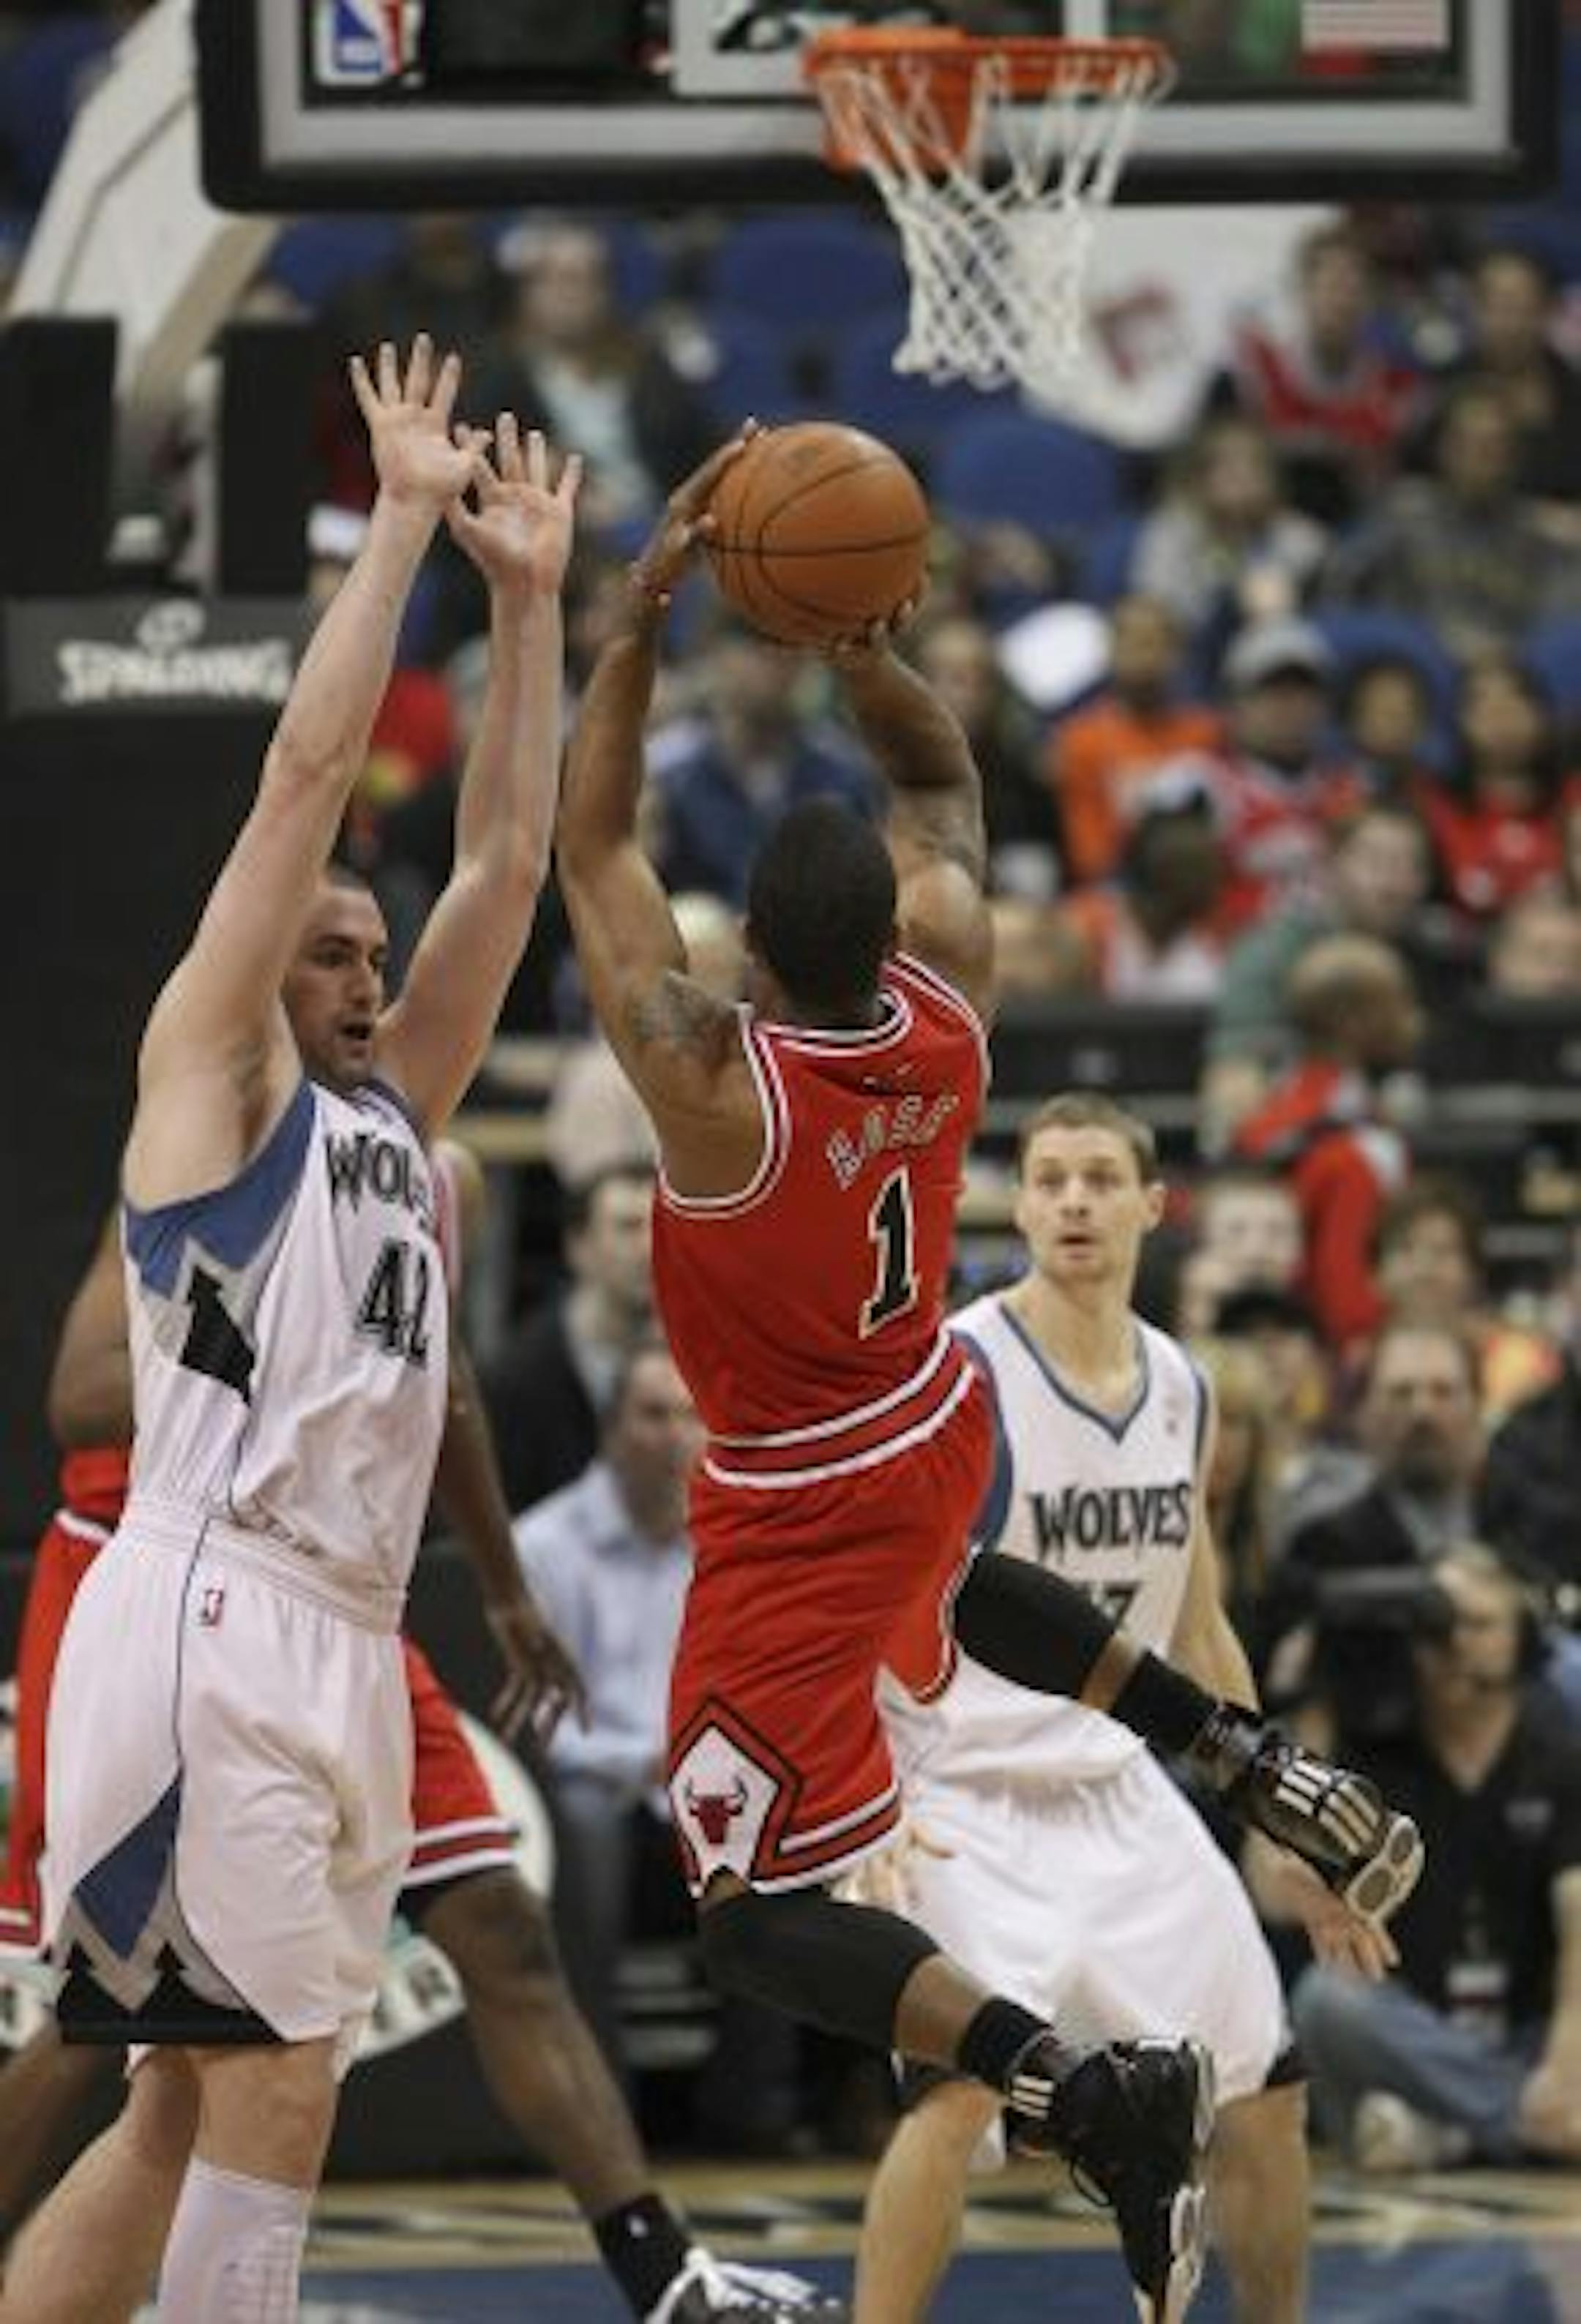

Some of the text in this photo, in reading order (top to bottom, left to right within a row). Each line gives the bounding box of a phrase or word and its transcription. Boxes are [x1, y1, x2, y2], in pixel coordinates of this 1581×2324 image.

[326, 1132, 430, 1226] WOL
[859, 1165, 920, 1341] 1
[1028, 1481, 1192, 1563] WOLVES
